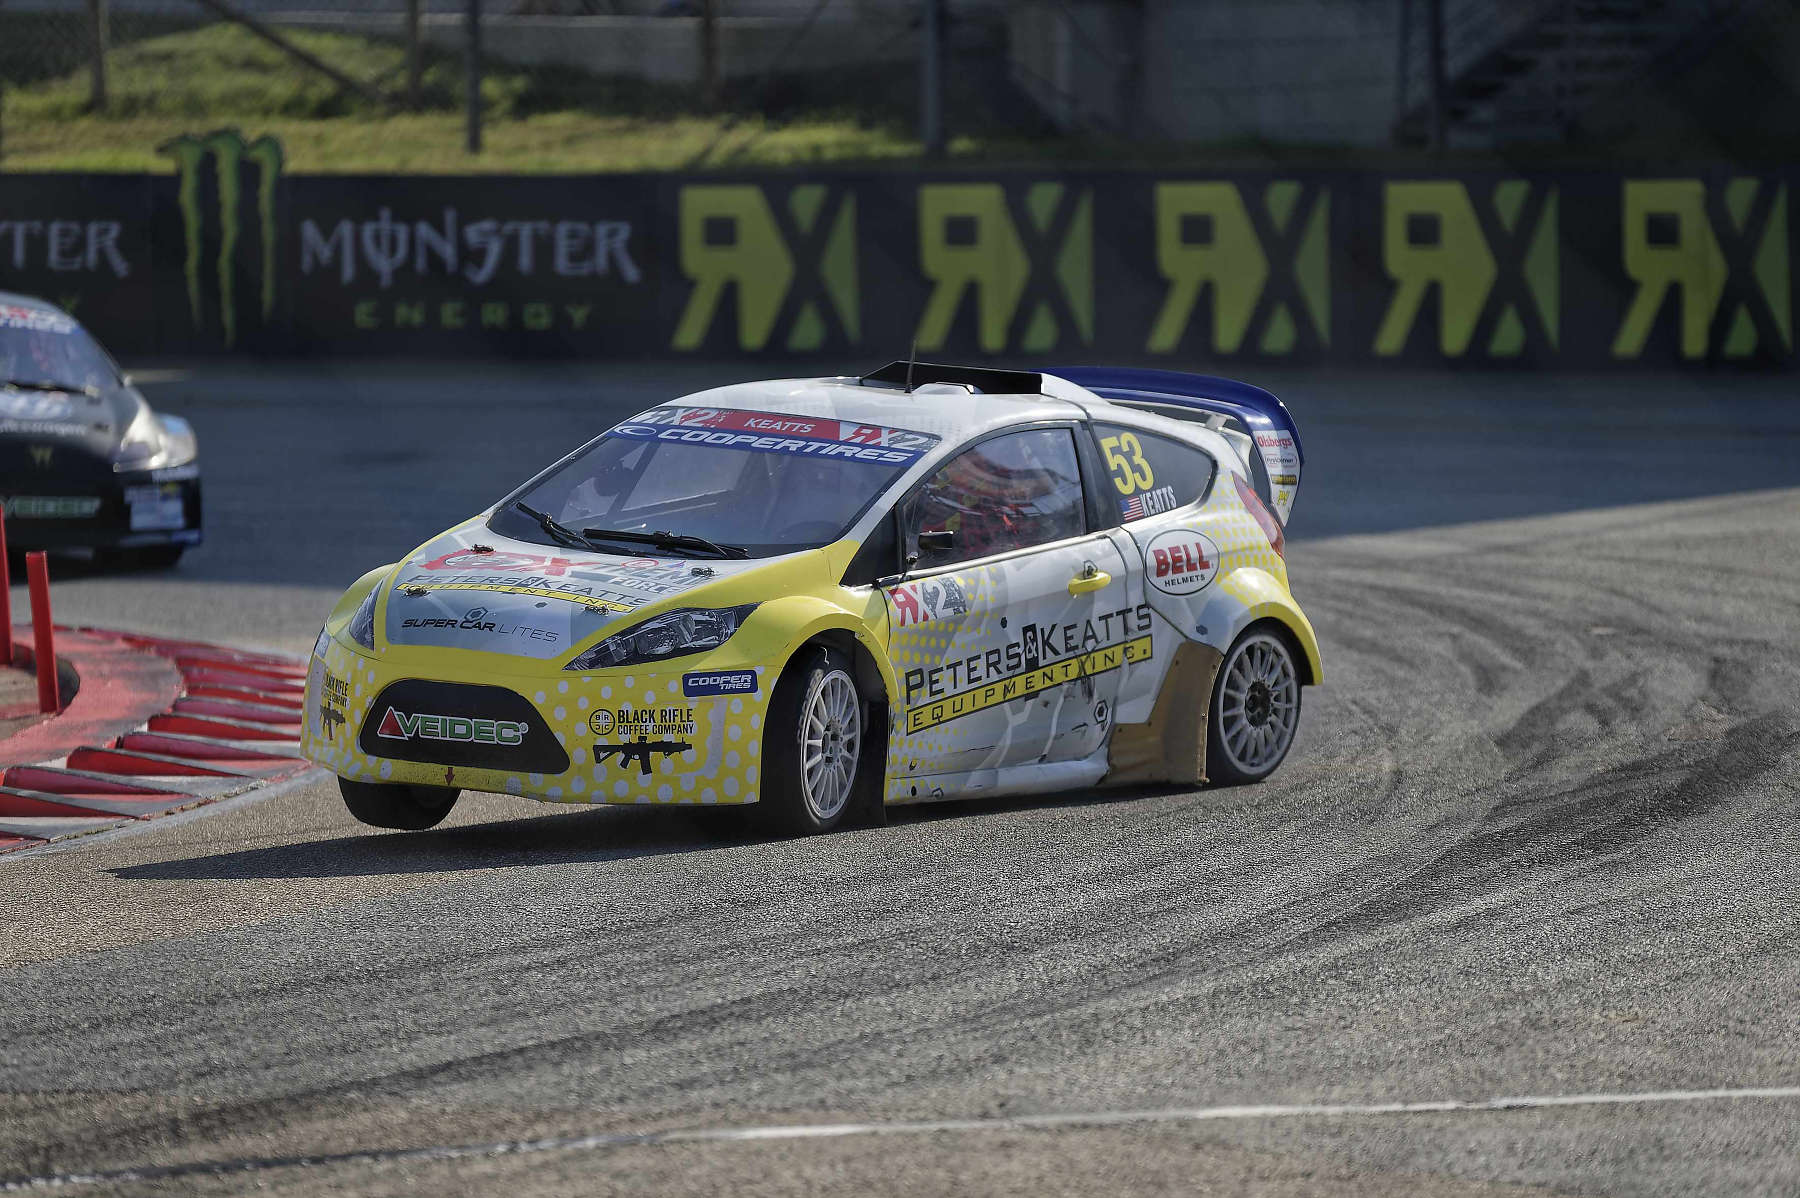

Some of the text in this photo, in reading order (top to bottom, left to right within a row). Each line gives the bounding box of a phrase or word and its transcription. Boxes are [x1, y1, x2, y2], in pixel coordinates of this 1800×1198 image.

[300, 206, 641, 288] MONSTER
[354, 301, 594, 330] ENERGY
[744, 417, 817, 434] KEATTS
[1100, 431, 1154, 495] 53
[1140, 486, 1177, 517] KEATTS
[1152, 542, 1211, 578] BELL
[1164, 573, 1206, 588] HELMETS
[499, 623, 560, 643] LITES
[688, 674, 752, 687] COOPER
[719, 682, 751, 690] TIRES
[912, 663, 1073, 728] EQUIPMENT
[617, 709, 694, 723] BLACK RIFLE
[395, 711, 523, 746] VEIDEC
[618, 723, 694, 735] COFFEE COMPANY
